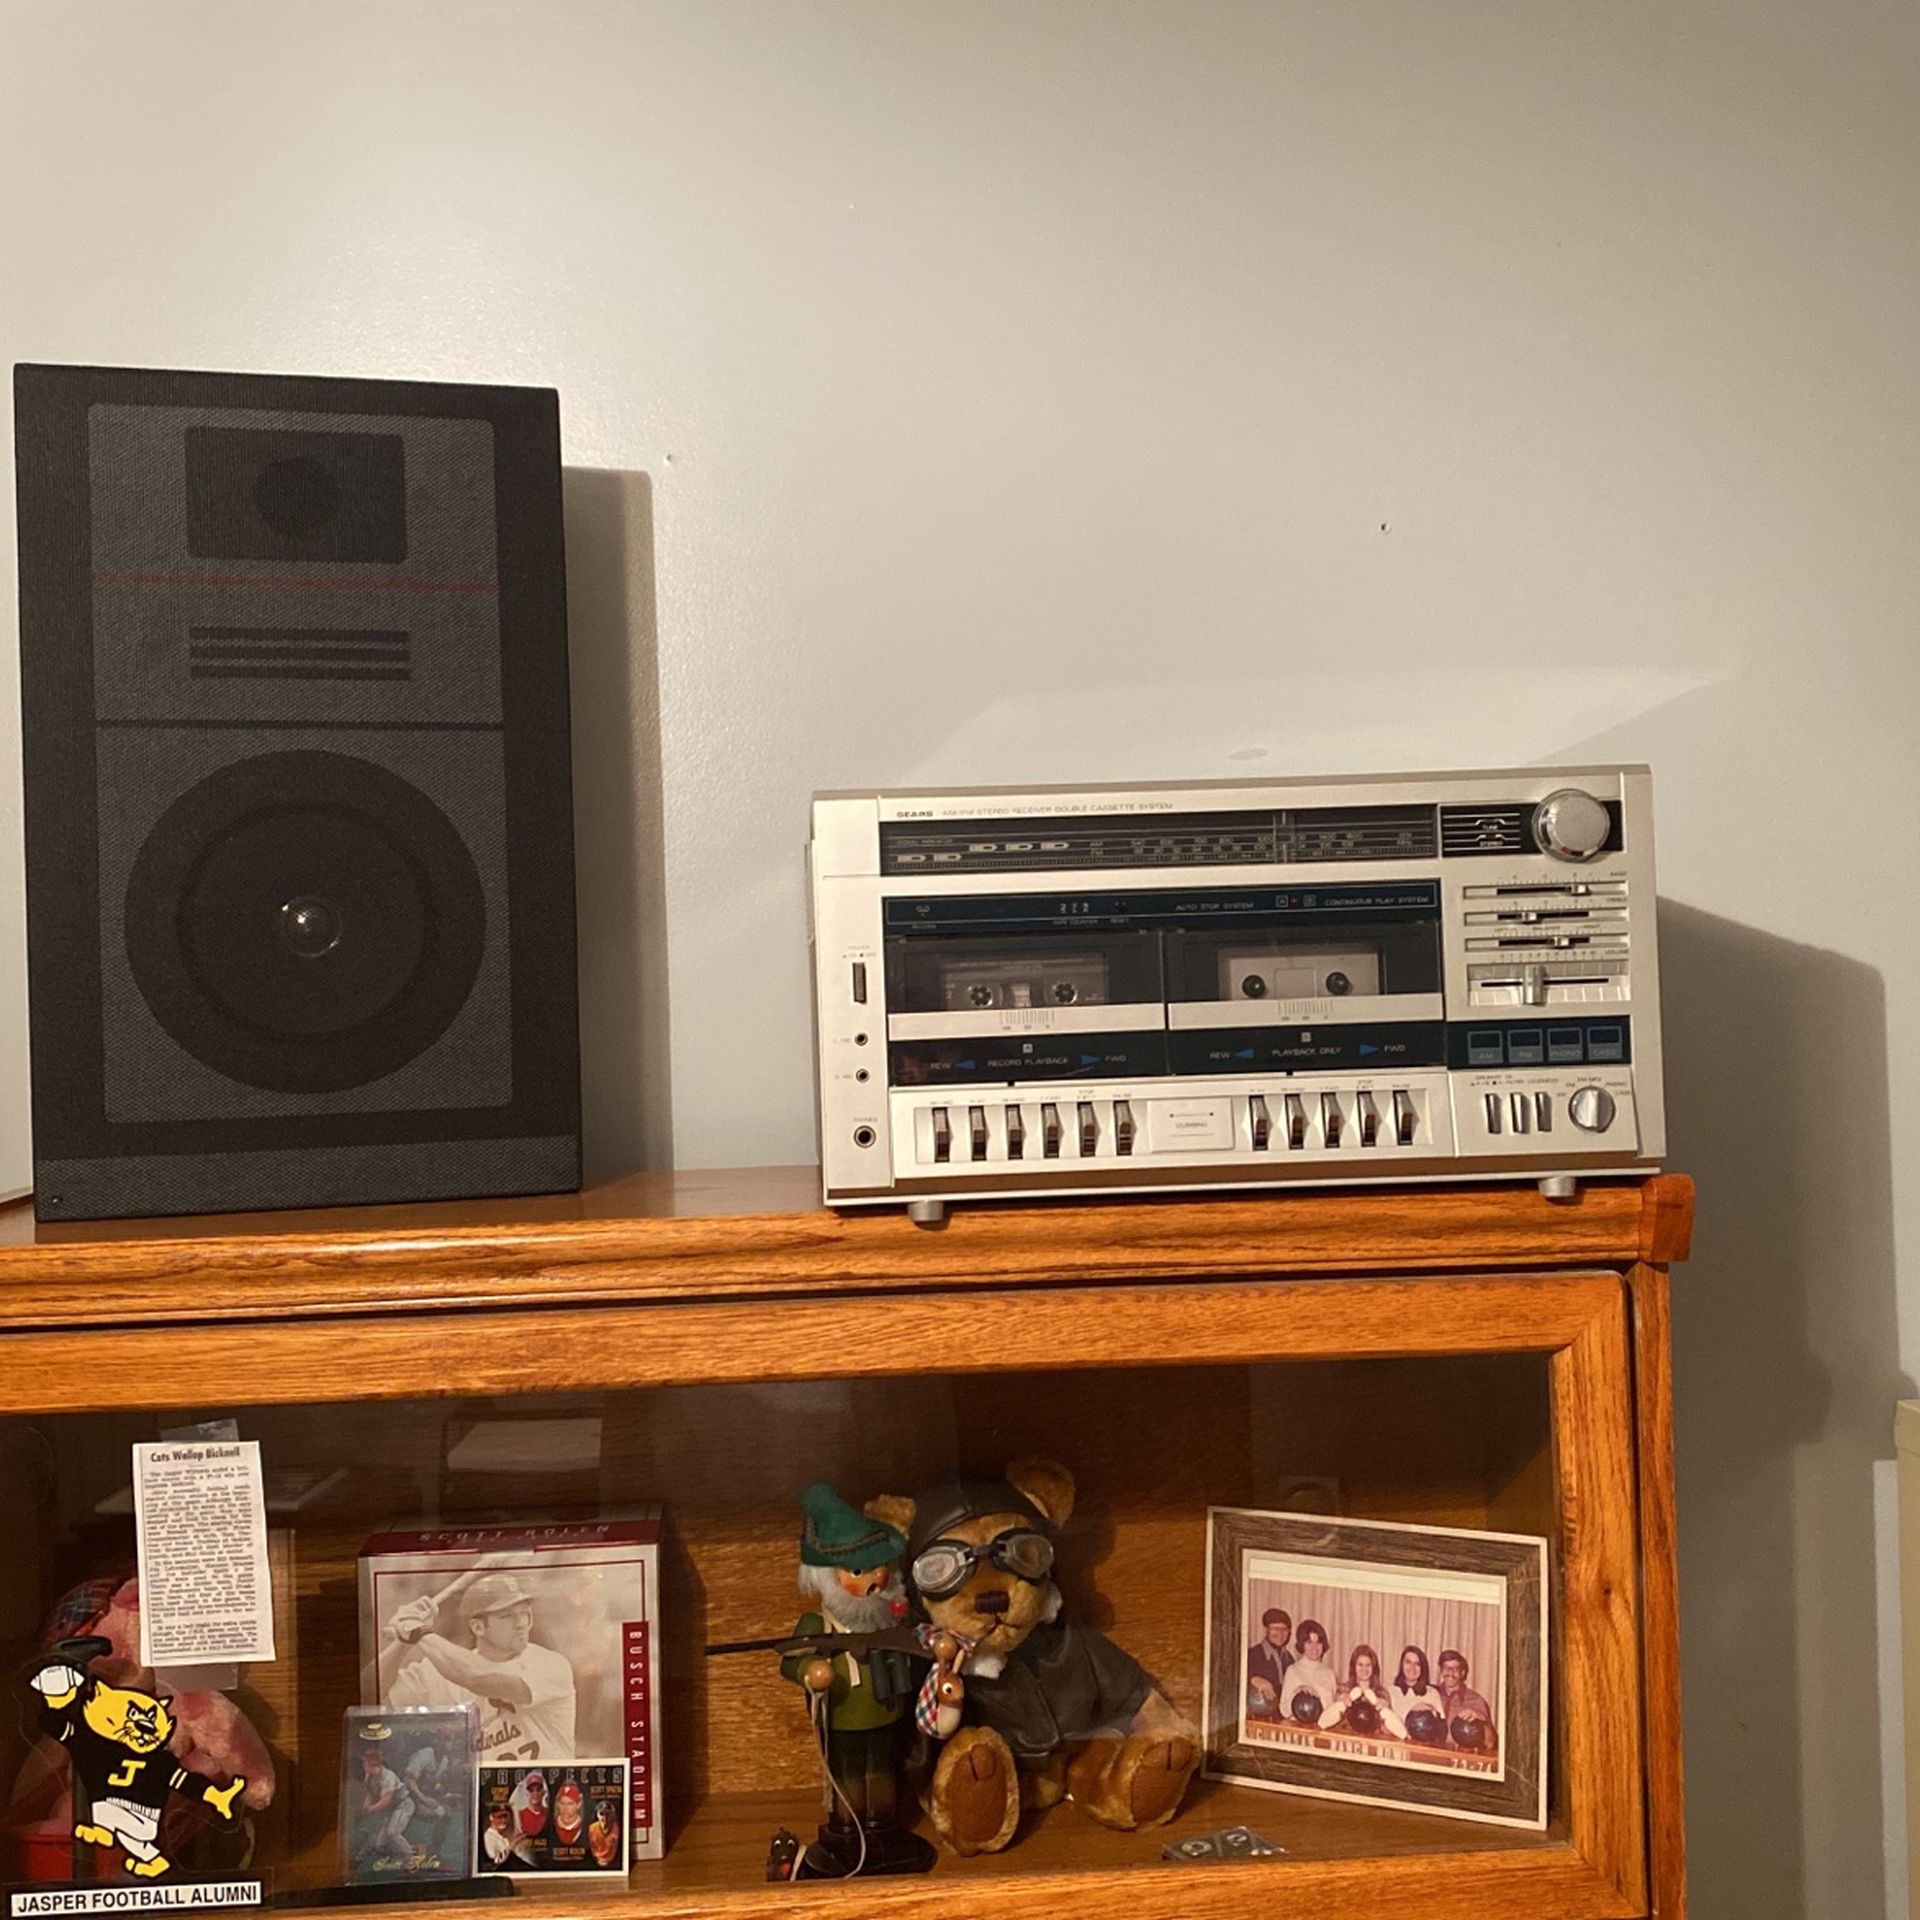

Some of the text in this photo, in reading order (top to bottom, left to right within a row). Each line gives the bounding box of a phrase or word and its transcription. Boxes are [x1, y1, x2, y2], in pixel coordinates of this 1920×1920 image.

[988, 1058, 1022, 1067] RECORD
[150, 1446, 240, 1463] Cats Wallop Bicknell
[419, 1525, 610, 1543] SCOTT ROLEN
[629, 1631, 647, 1820] BUSCH STADIUM
[107, 1759, 146, 1787] J
[480, 1766, 623, 1786] PROPECTS
[18, 1884, 258, 1914] JASPER FOOTBALL ALUMNI
